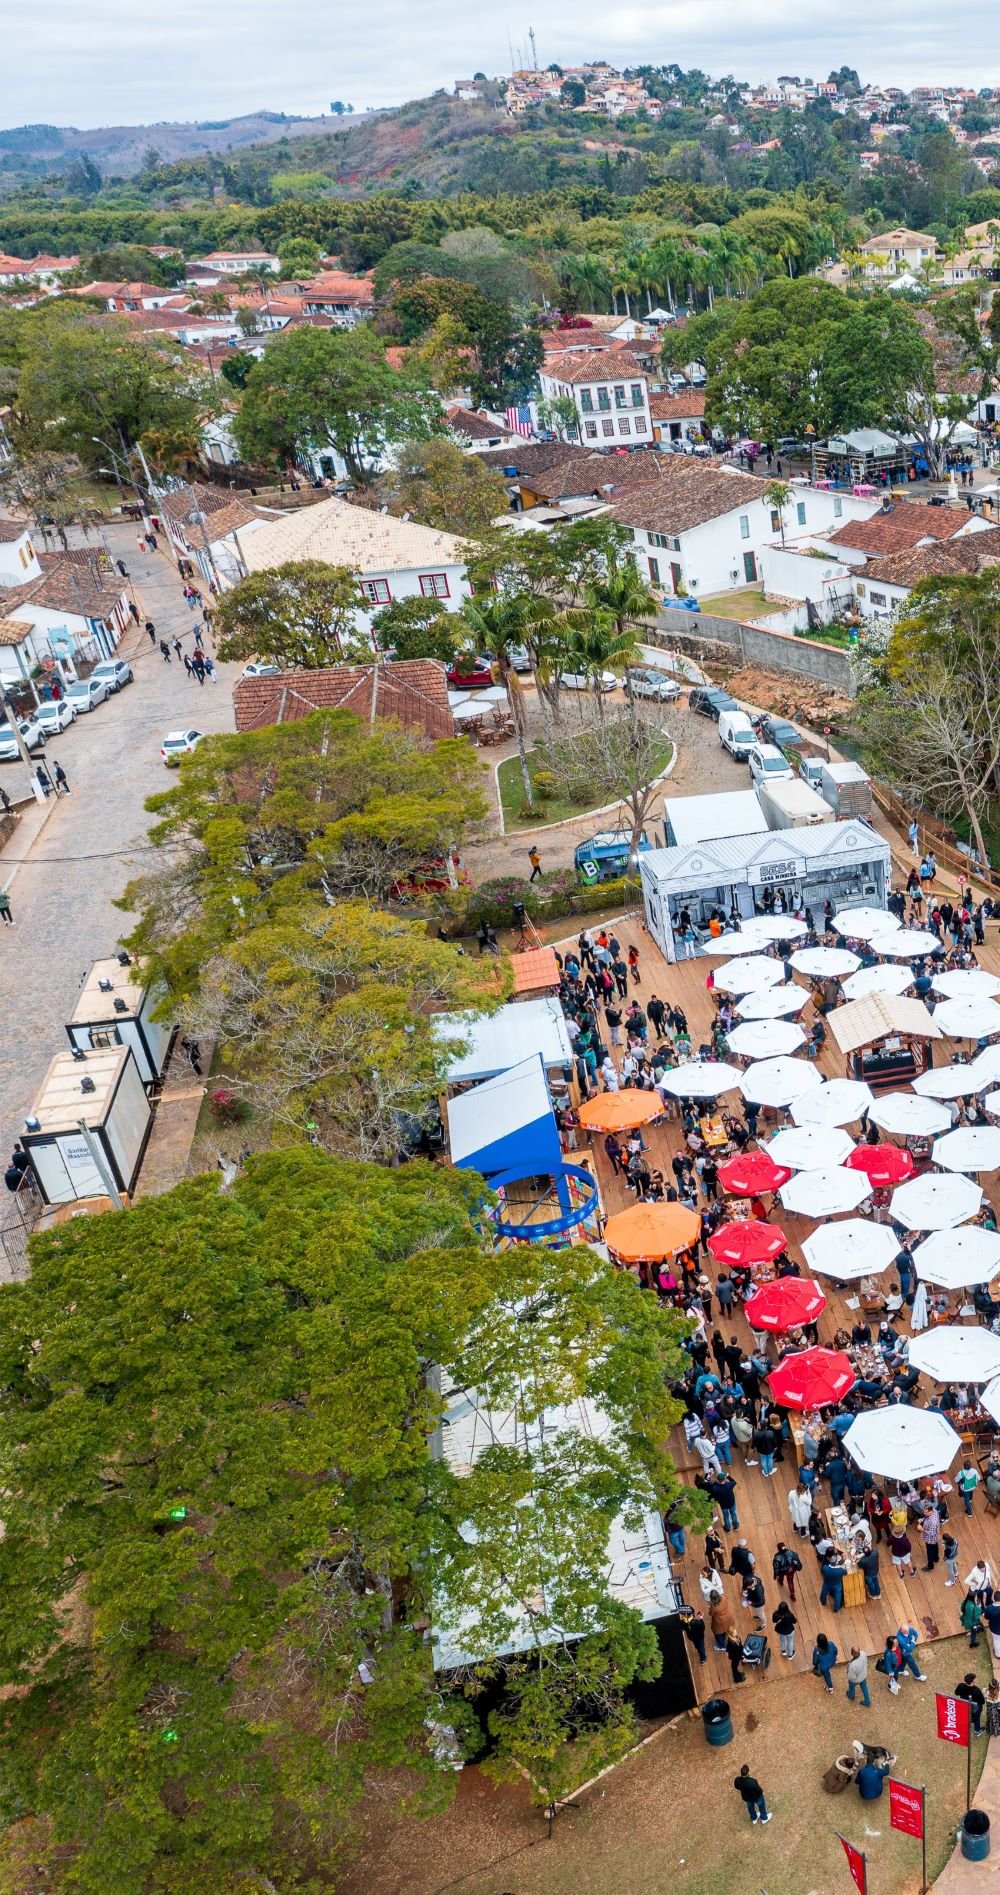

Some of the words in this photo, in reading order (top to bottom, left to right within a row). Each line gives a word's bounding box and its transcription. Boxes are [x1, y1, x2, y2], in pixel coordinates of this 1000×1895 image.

[760, 861, 796, 877] SESC
[775, 871, 797, 880] MINEIRA
[944, 1698, 957, 1728] bradesco
